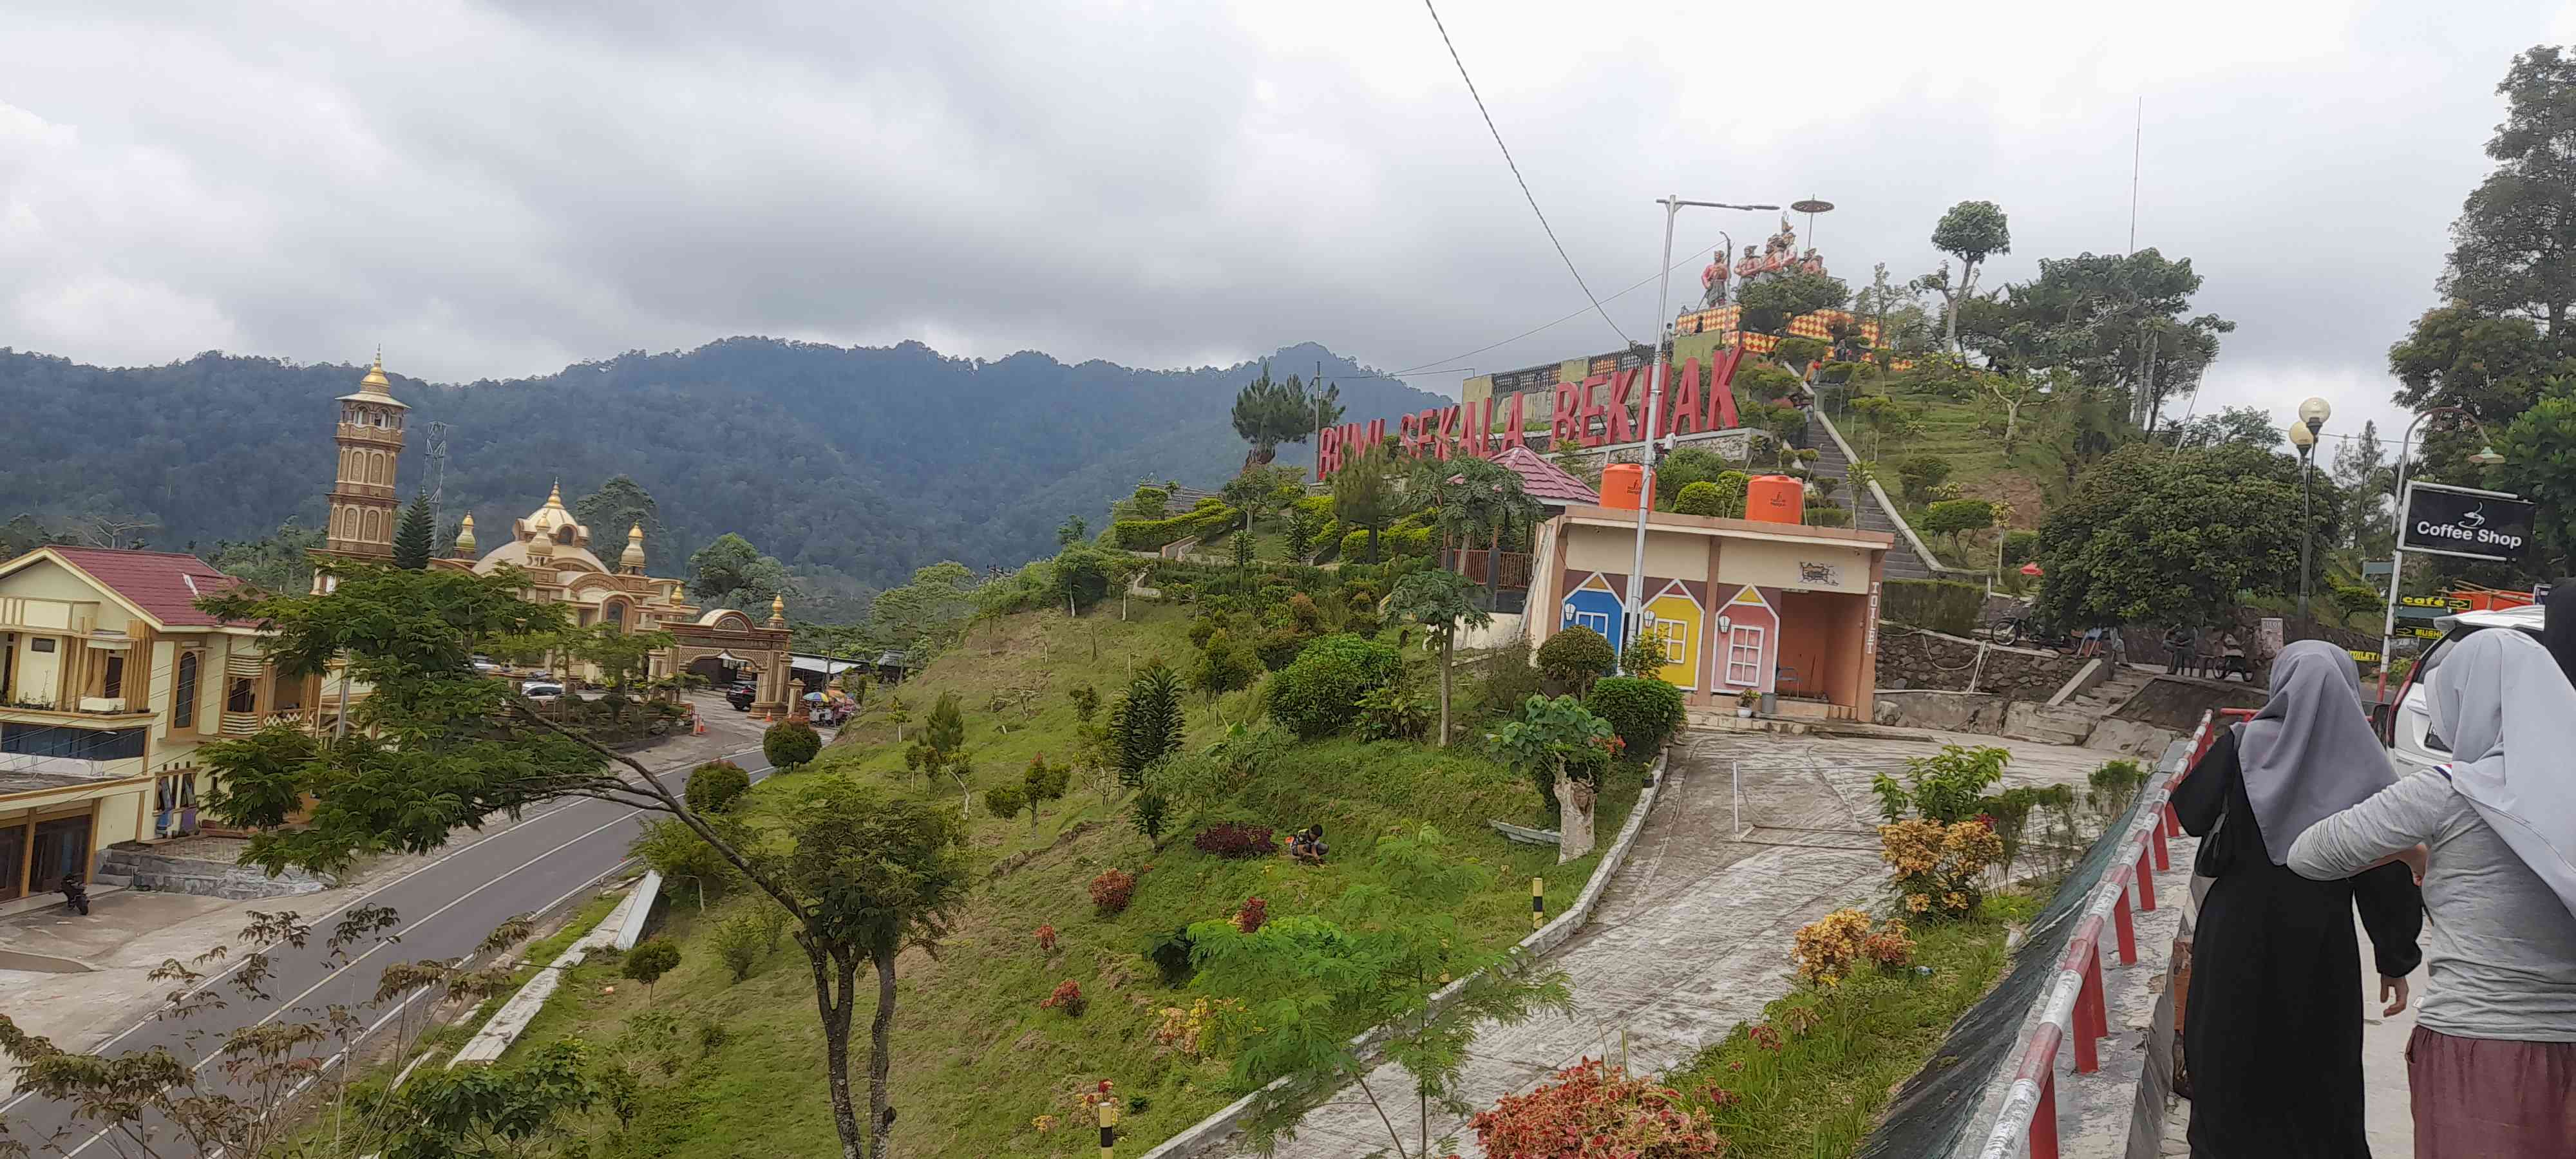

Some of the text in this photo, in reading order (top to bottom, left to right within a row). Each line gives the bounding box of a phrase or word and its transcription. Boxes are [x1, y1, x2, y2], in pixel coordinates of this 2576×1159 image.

[1399, 391, 1524, 463] SEKALA
[1549, 344, 1744, 451] BEKHAK
[2417, 521, 2523, 549] Coffee Shop
[1866, 581, 1879, 654] TOILET
